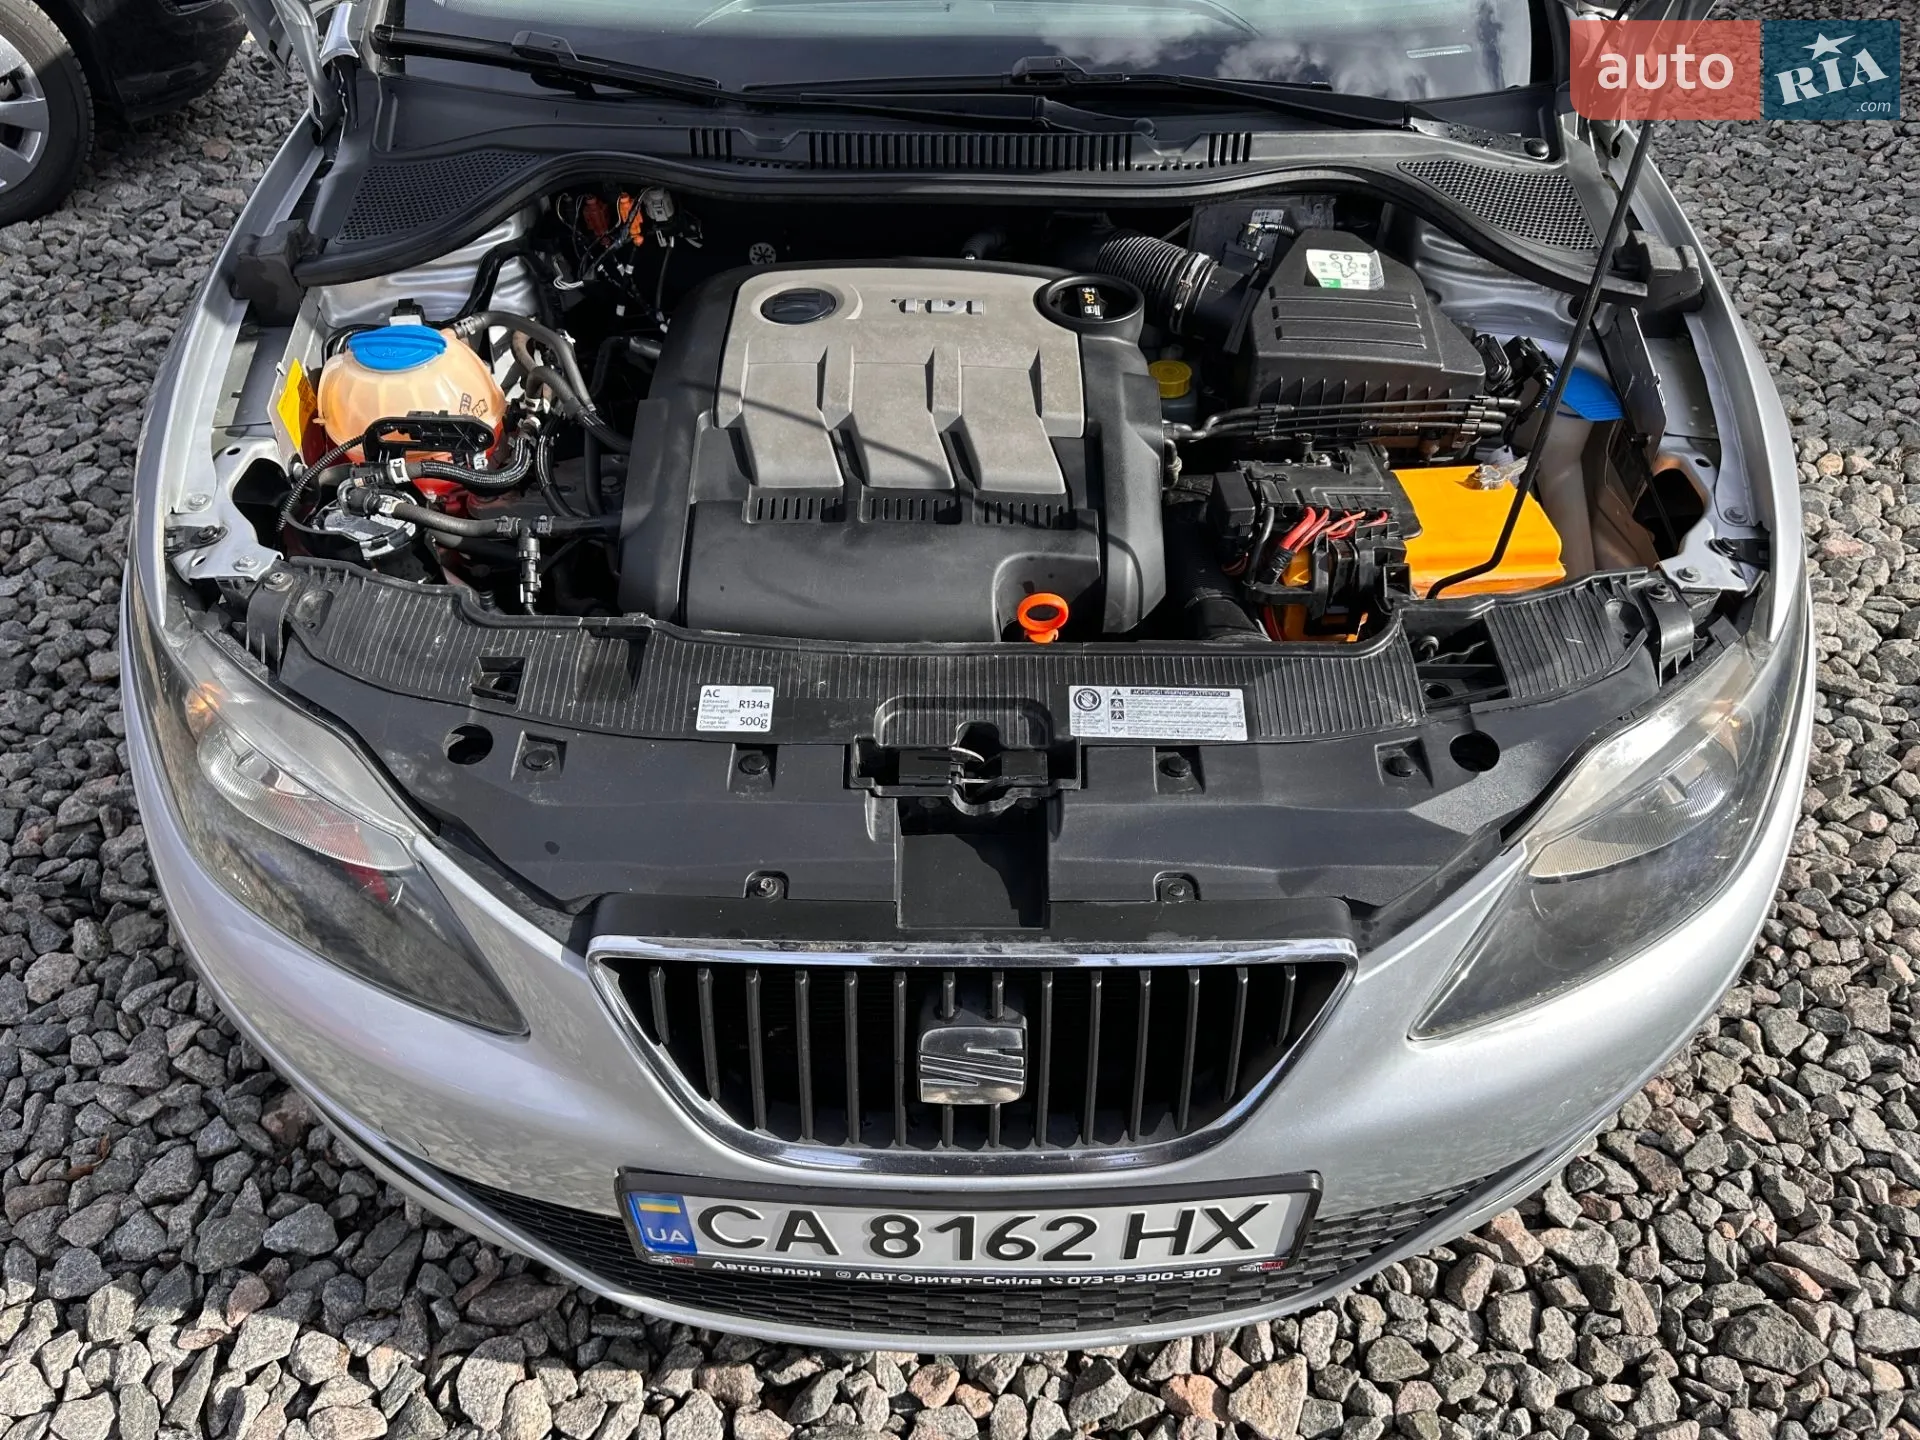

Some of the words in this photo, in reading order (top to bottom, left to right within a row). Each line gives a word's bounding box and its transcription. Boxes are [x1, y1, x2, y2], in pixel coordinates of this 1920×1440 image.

[703, 689, 721, 698] AC
[738, 699, 770, 709] R134a
[739, 716, 768, 729] 500g
[647, 1227, 689, 1244] UA
[697, 1204, 841, 1256] CA
[869, 1213, 1097, 1262] 8162
[1120, 1202, 1271, 1260] HX
[712, 1261, 822, 1277] Автосалон
[1067, 1268, 1222, 1284] 073-9-300-300
